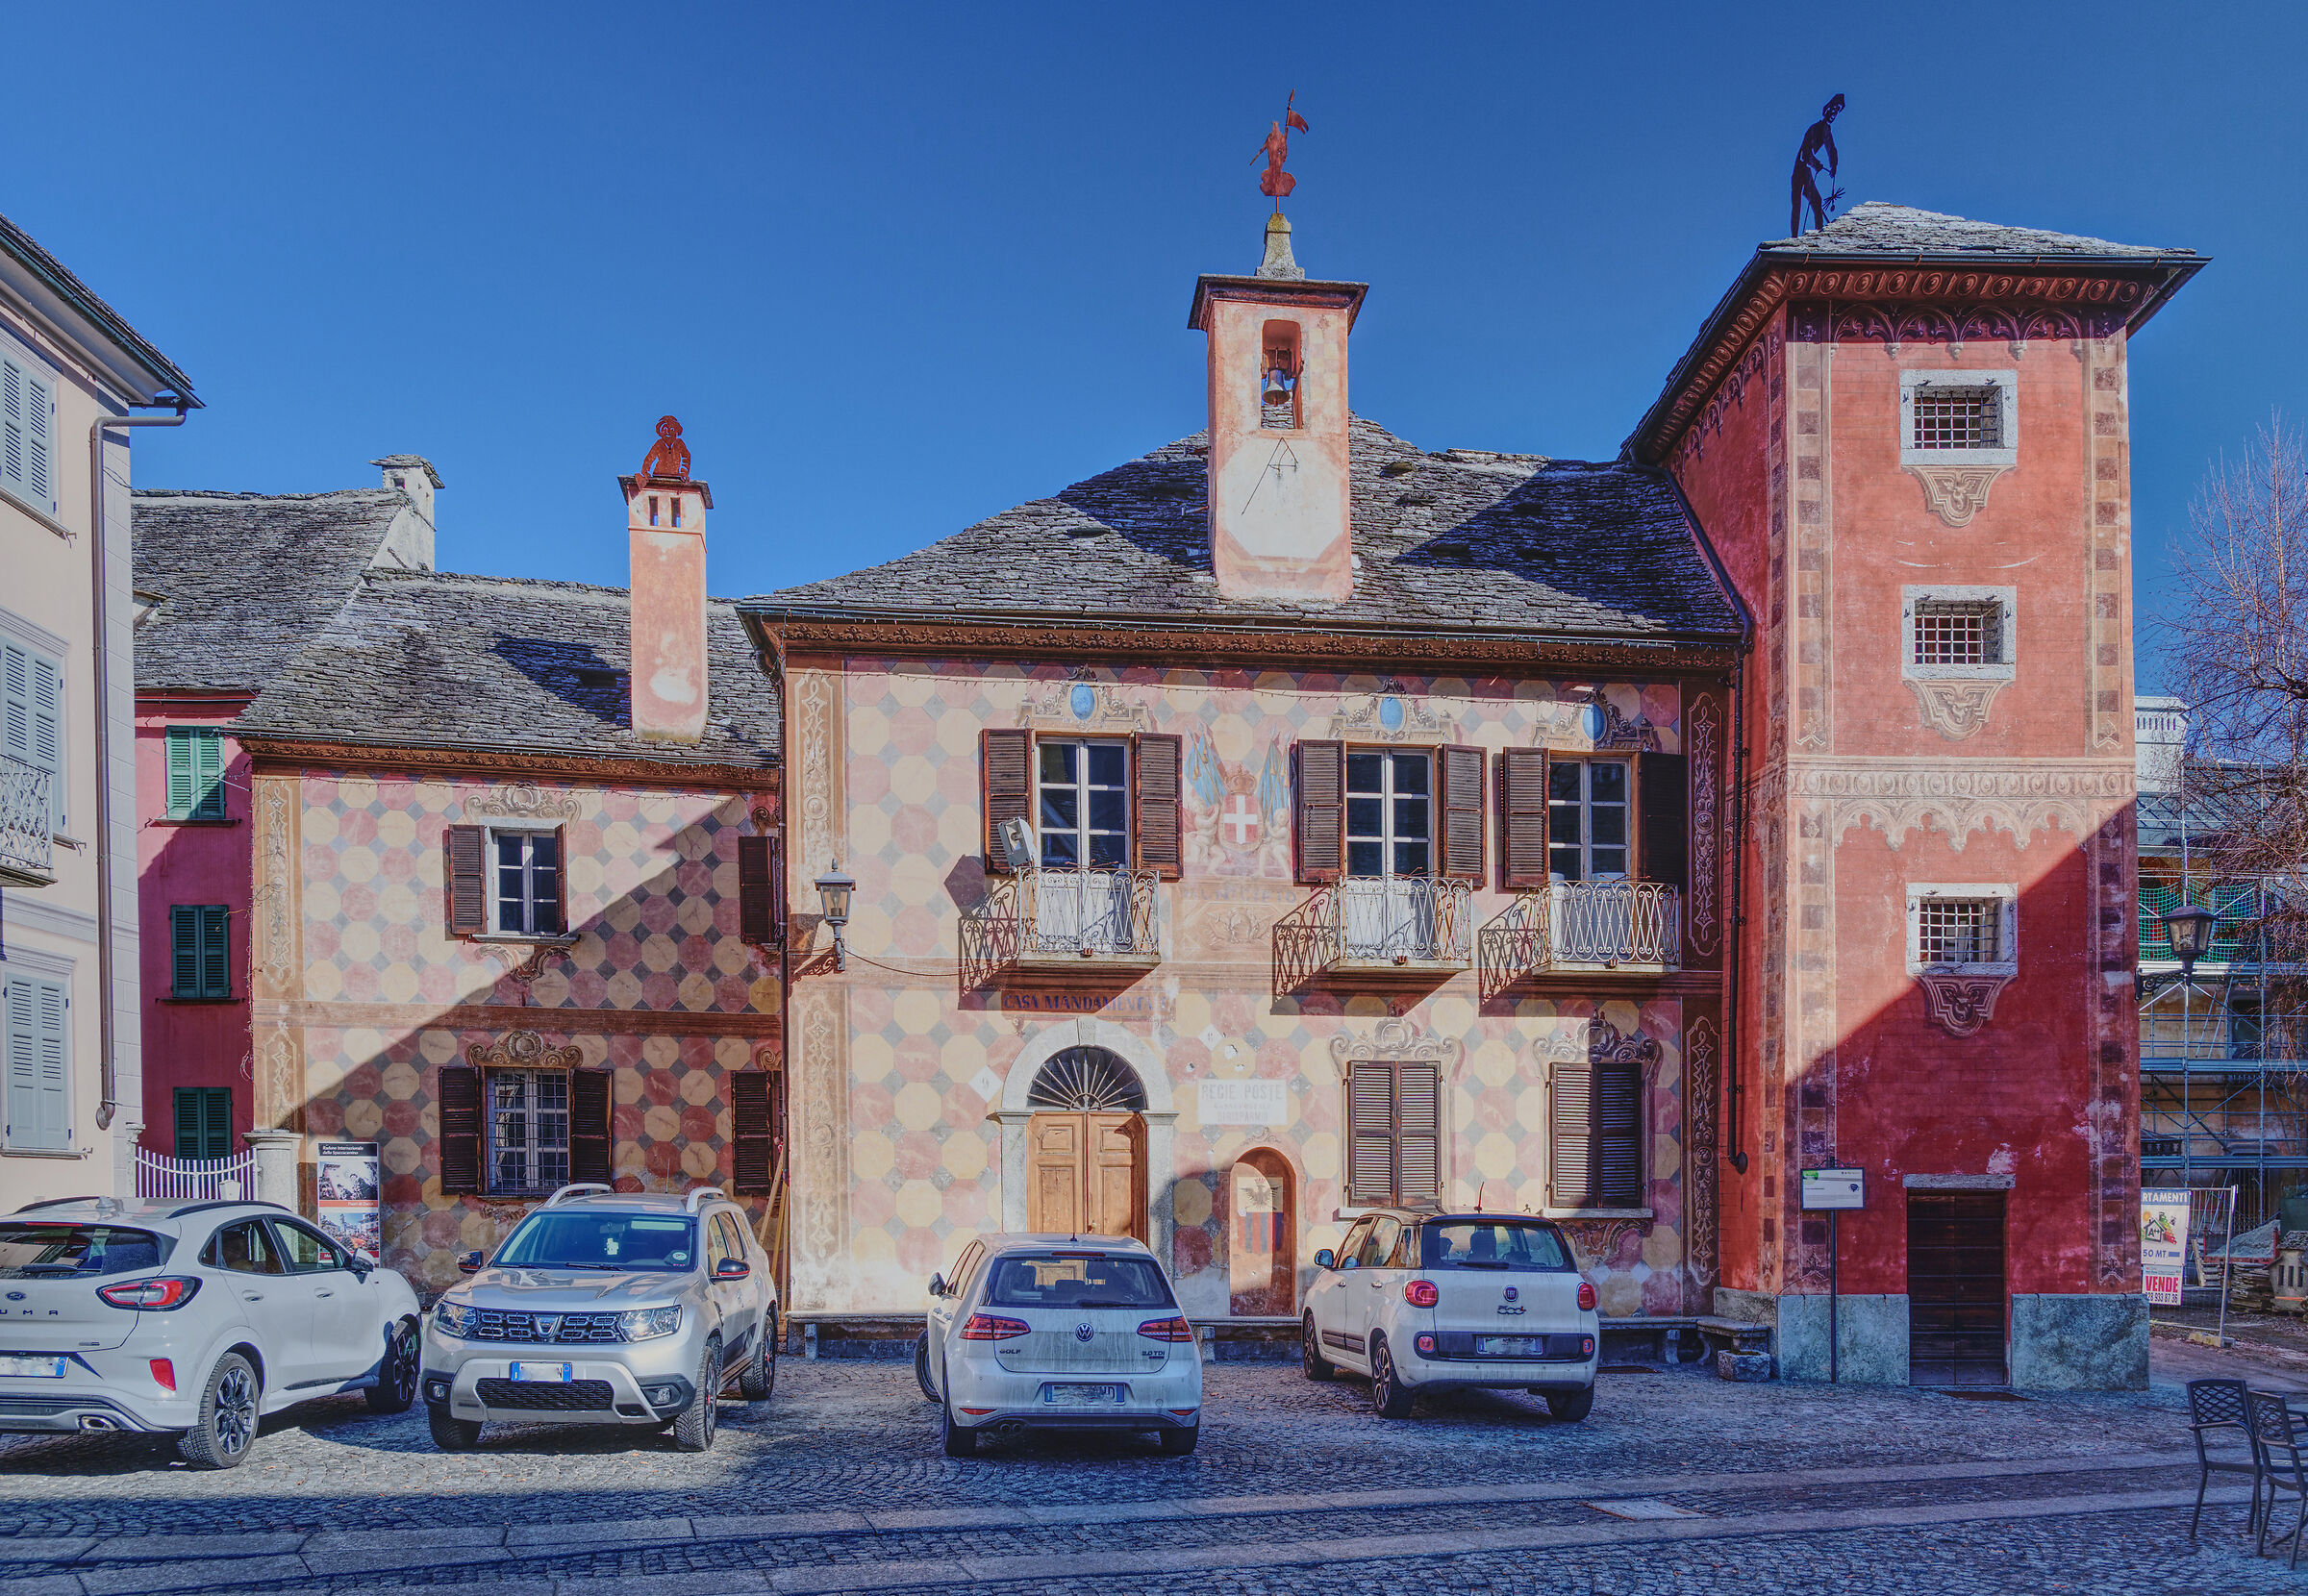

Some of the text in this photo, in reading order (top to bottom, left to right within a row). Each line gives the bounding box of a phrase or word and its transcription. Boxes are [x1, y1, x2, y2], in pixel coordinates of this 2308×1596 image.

[1003, 994, 1167, 1011] CASA MANDAMENTAE
[1200, 1084, 1283, 1102] REGIE POSTE
[2143, 1191, 2188, 1203] RTAMENTI
[2143, 1249, 2154, 1258] 50
[2145, 1275, 2179, 1293] VENDE
